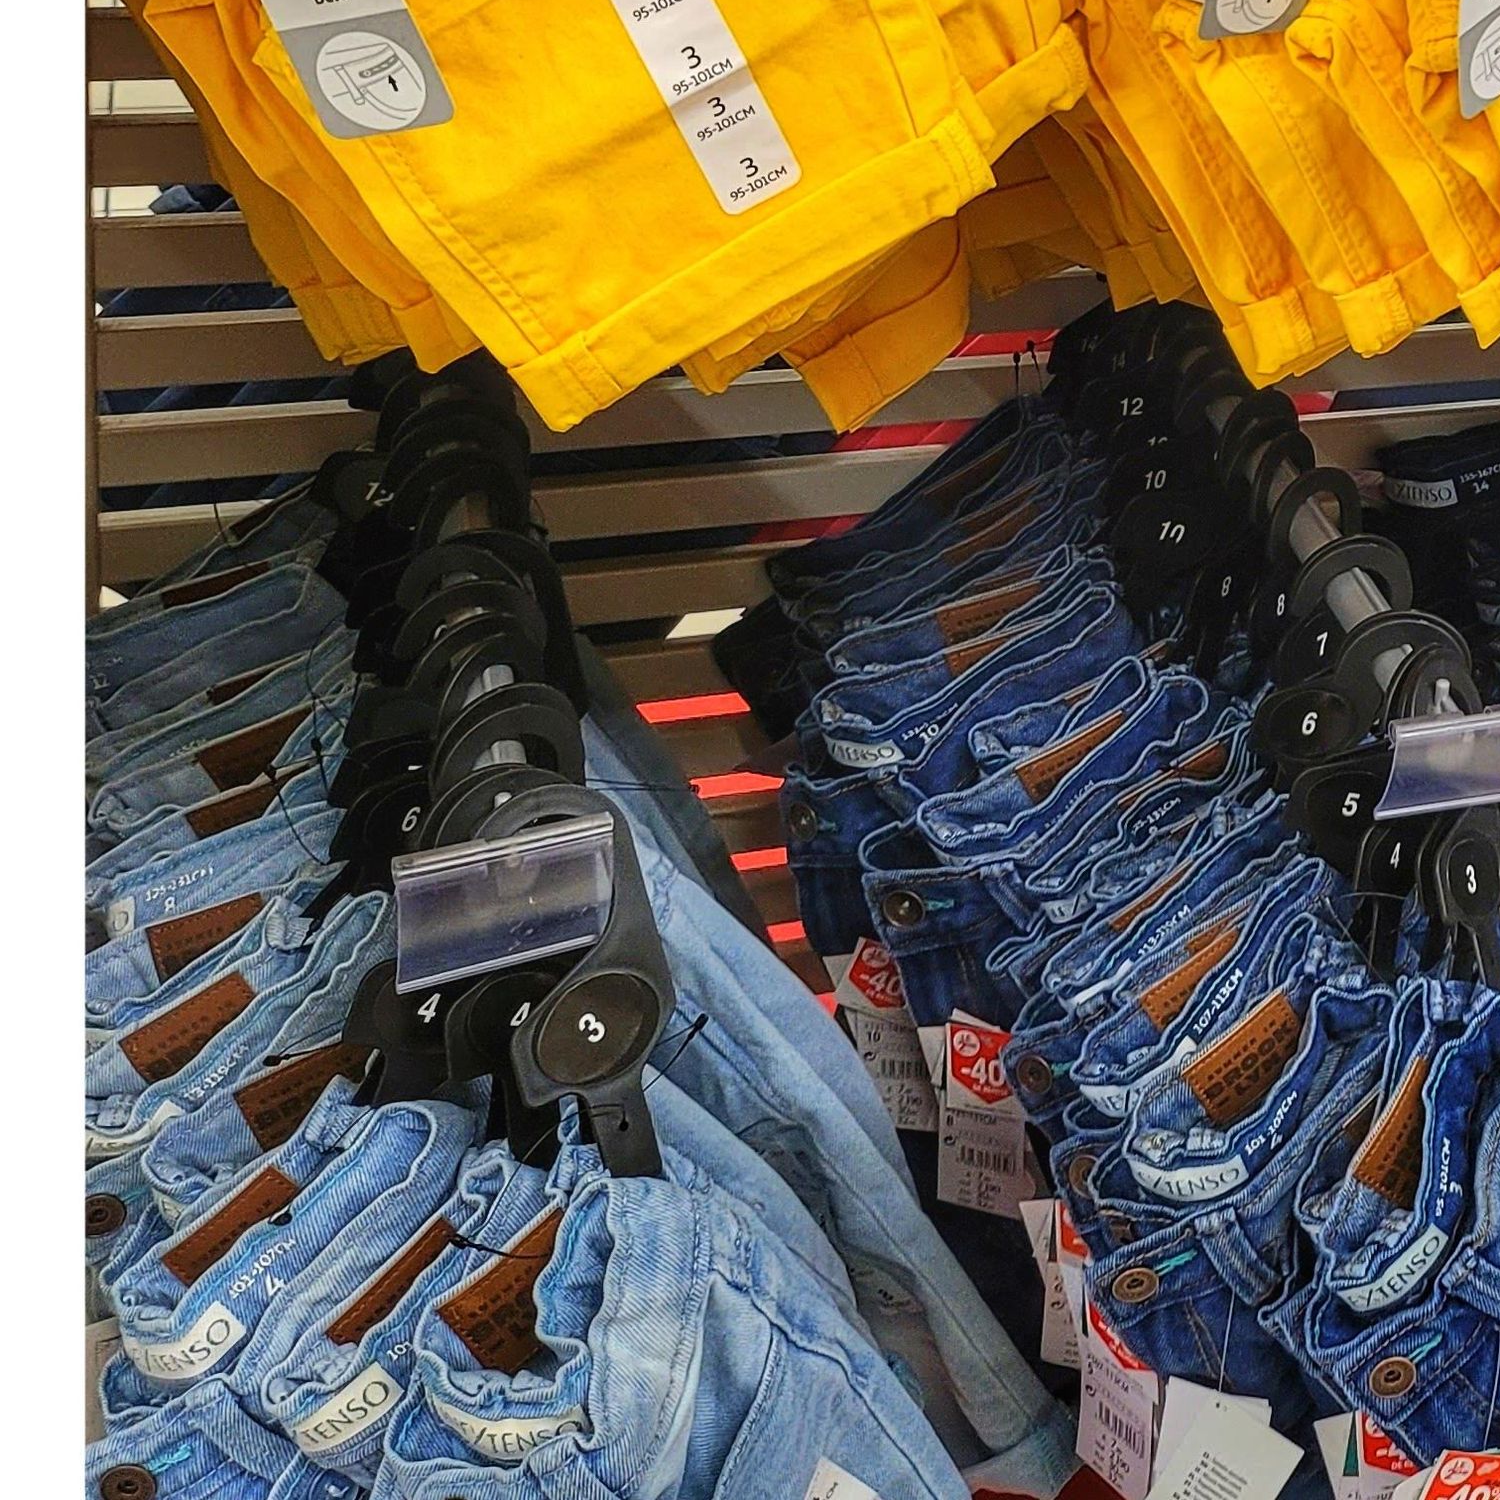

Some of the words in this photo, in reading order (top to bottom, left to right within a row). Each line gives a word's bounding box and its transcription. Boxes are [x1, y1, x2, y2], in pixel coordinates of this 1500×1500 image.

[680, 46, 702, 70] 3
[672, 58, 734, 96] 95-101CM
[707, 96, 727, 118] 3
[696, 105, 756, 142] 95-101CM
[739, 157, 759, 178] 3
[730, 165, 788, 202] 95-101CM
[1120, 397, 1145, 418] 12
[1144, 469, 1167, 491] 10
[1473, 480, 1489, 494] 14
[1221, 575, 1233, 598] 8
[1276, 592, 1286, 617] 8
[1316, 631, 1329, 657] 7
[919, 724, 940, 745] 10
[1301, 710, 1319, 737] 6
[1341, 792, 1360, 817] 5
[401, 805, 421, 834] 6
[1390, 842, 1402, 869] 4
[1464, 864, 1478, 896] 3
[416, 992, 442, 1024] 4
[1192, 967, 1245, 1035] 107-113CM
[577, 1011, 607, 1044] 3
[1270, 1133, 1283, 1150] 4
[263, 1272, 286, 1298] 4
